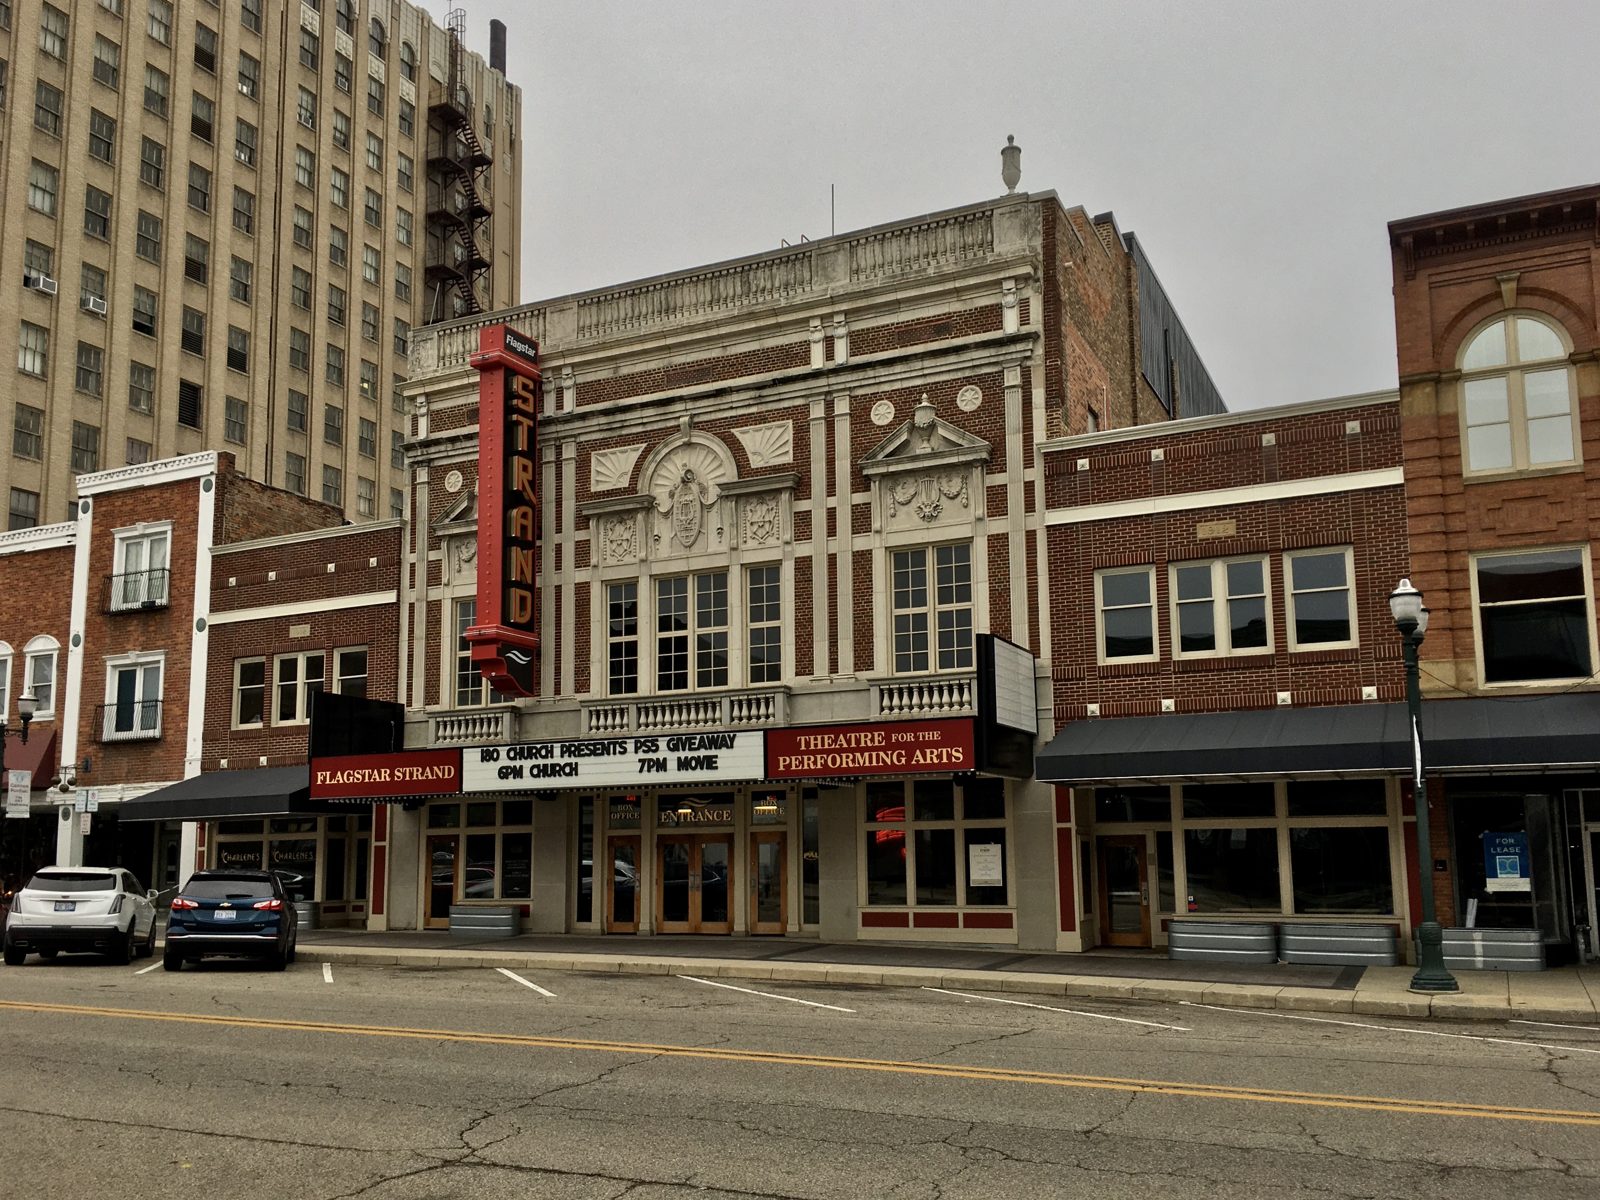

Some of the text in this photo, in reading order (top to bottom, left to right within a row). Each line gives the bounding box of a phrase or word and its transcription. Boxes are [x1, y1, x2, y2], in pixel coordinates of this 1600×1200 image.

[506, 334, 536, 357] Flagstar
[511, 374, 537, 625] STRAND
[506, 745, 554, 760] CHURCH
[560, 740, 628, 759] PRESENTS
[634, 738, 660, 754] PS5
[666, 733, 737, 752] GIVEAWAY
[796, 731, 942, 751] THEATRE FOR THE
[497, 755, 719, 780] 6PM CHURCH 7PM MOVIE
[777, 747, 964, 771] PERFORMING ARTS
[316, 765, 455, 785] FLAGSTAR STRAND
[611, 812, 640, 820] OFFICE
[661, 809, 731, 823] ENTRANCE
